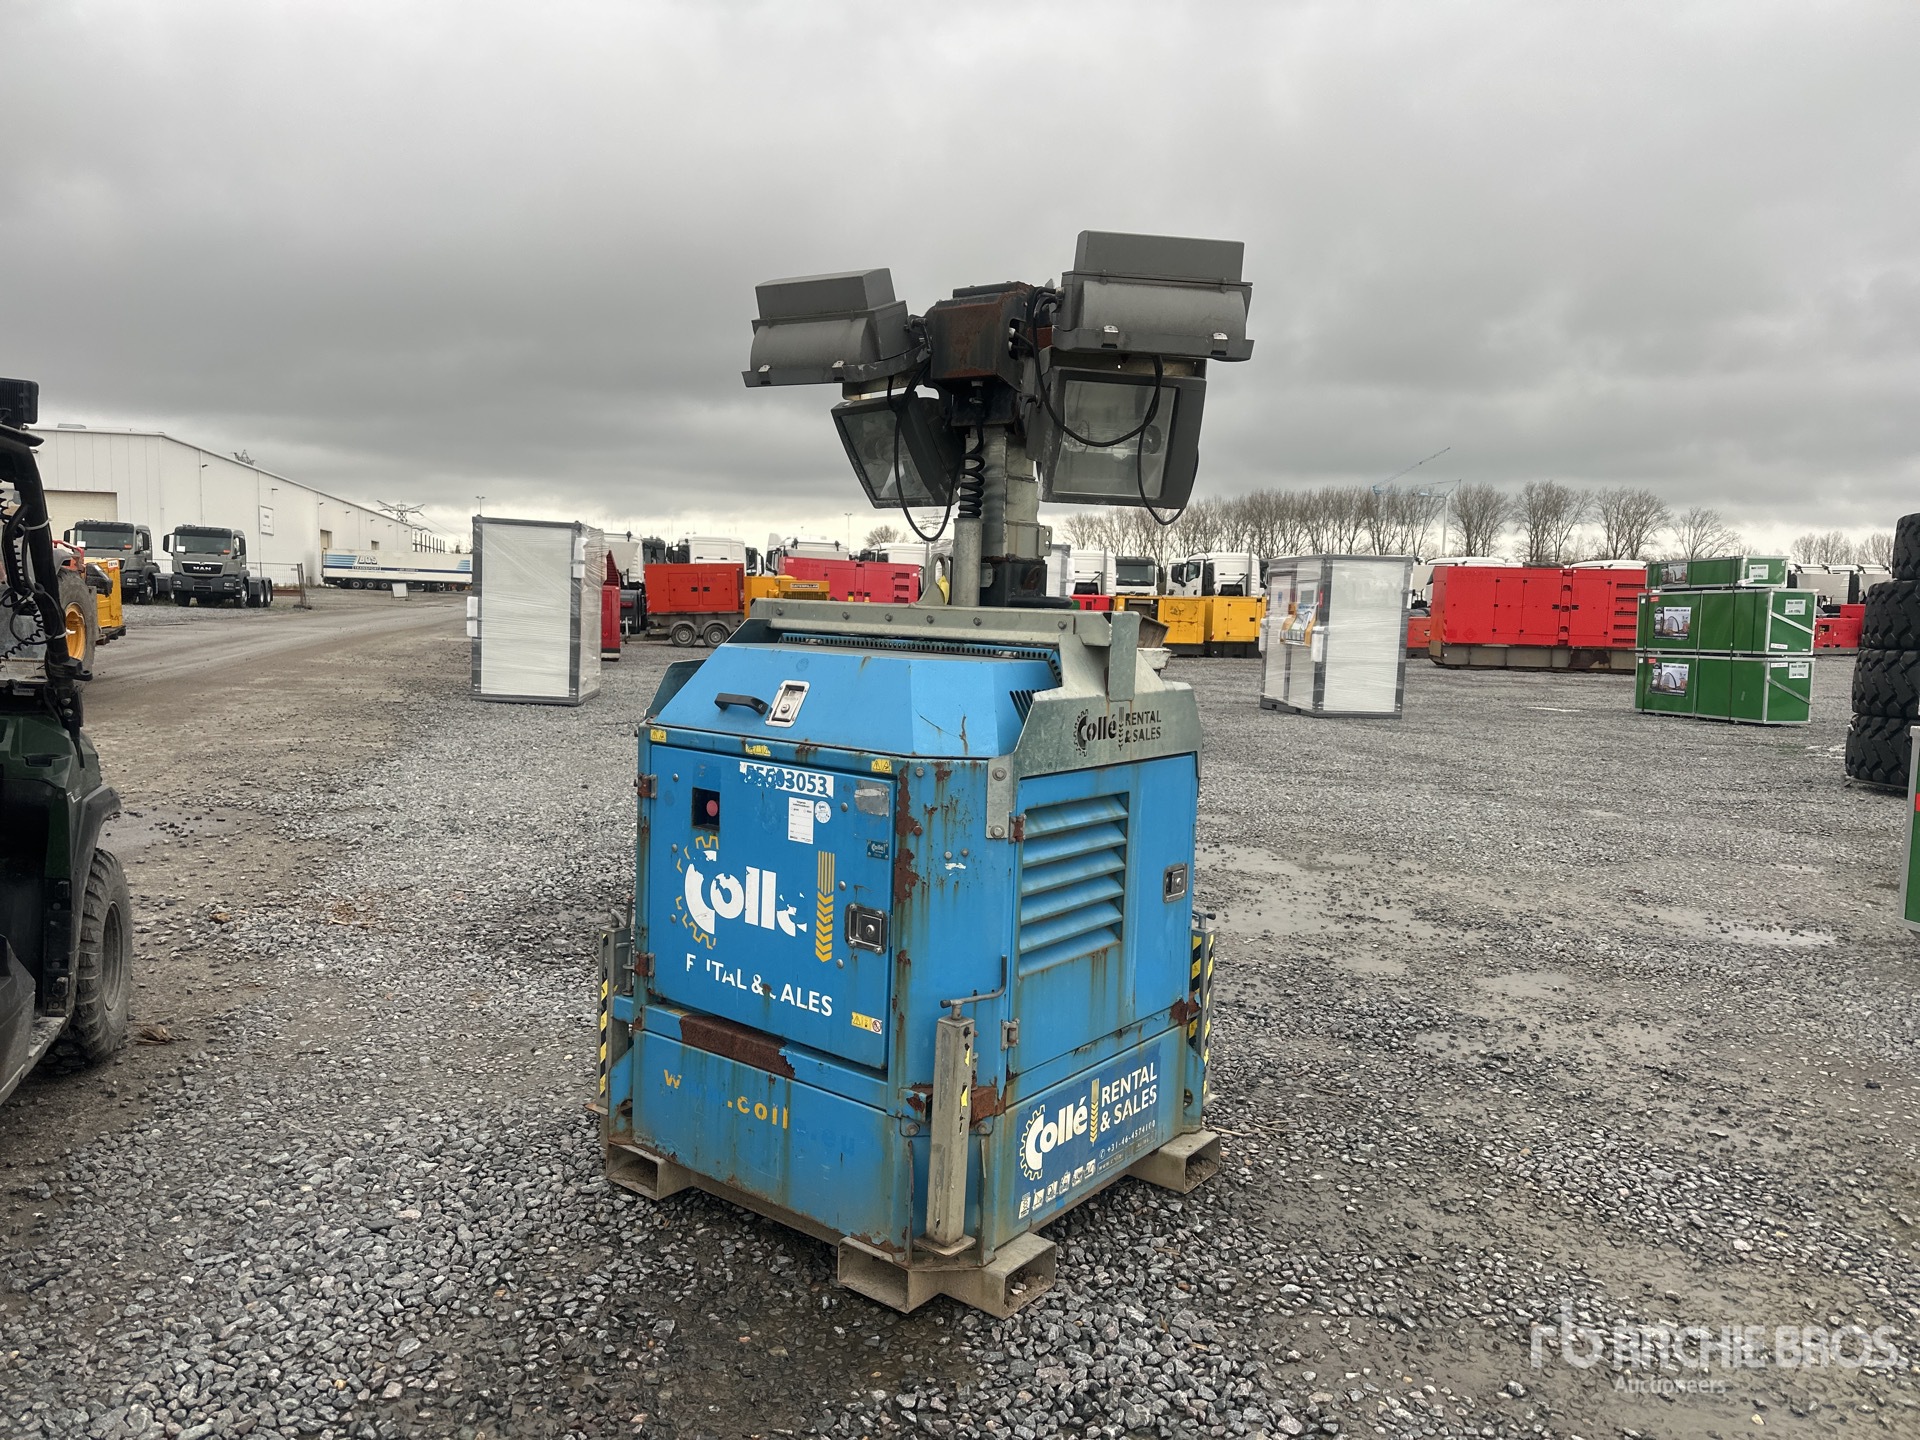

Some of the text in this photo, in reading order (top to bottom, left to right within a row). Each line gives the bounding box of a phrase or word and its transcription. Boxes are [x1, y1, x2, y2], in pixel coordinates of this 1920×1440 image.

[1077, 713, 1117, 750] Collé
[1125, 710, 1162, 727] RENTAL
[1133, 727, 1161, 743] SALES
[751, 974, 764, 996] &
[768, 980, 834, 1018] ALES
[1101, 1062, 1158, 1108] RENTAL
[1100, 1085, 1158, 1133] & SALES
[1025, 1096, 1088, 1171] Collé
